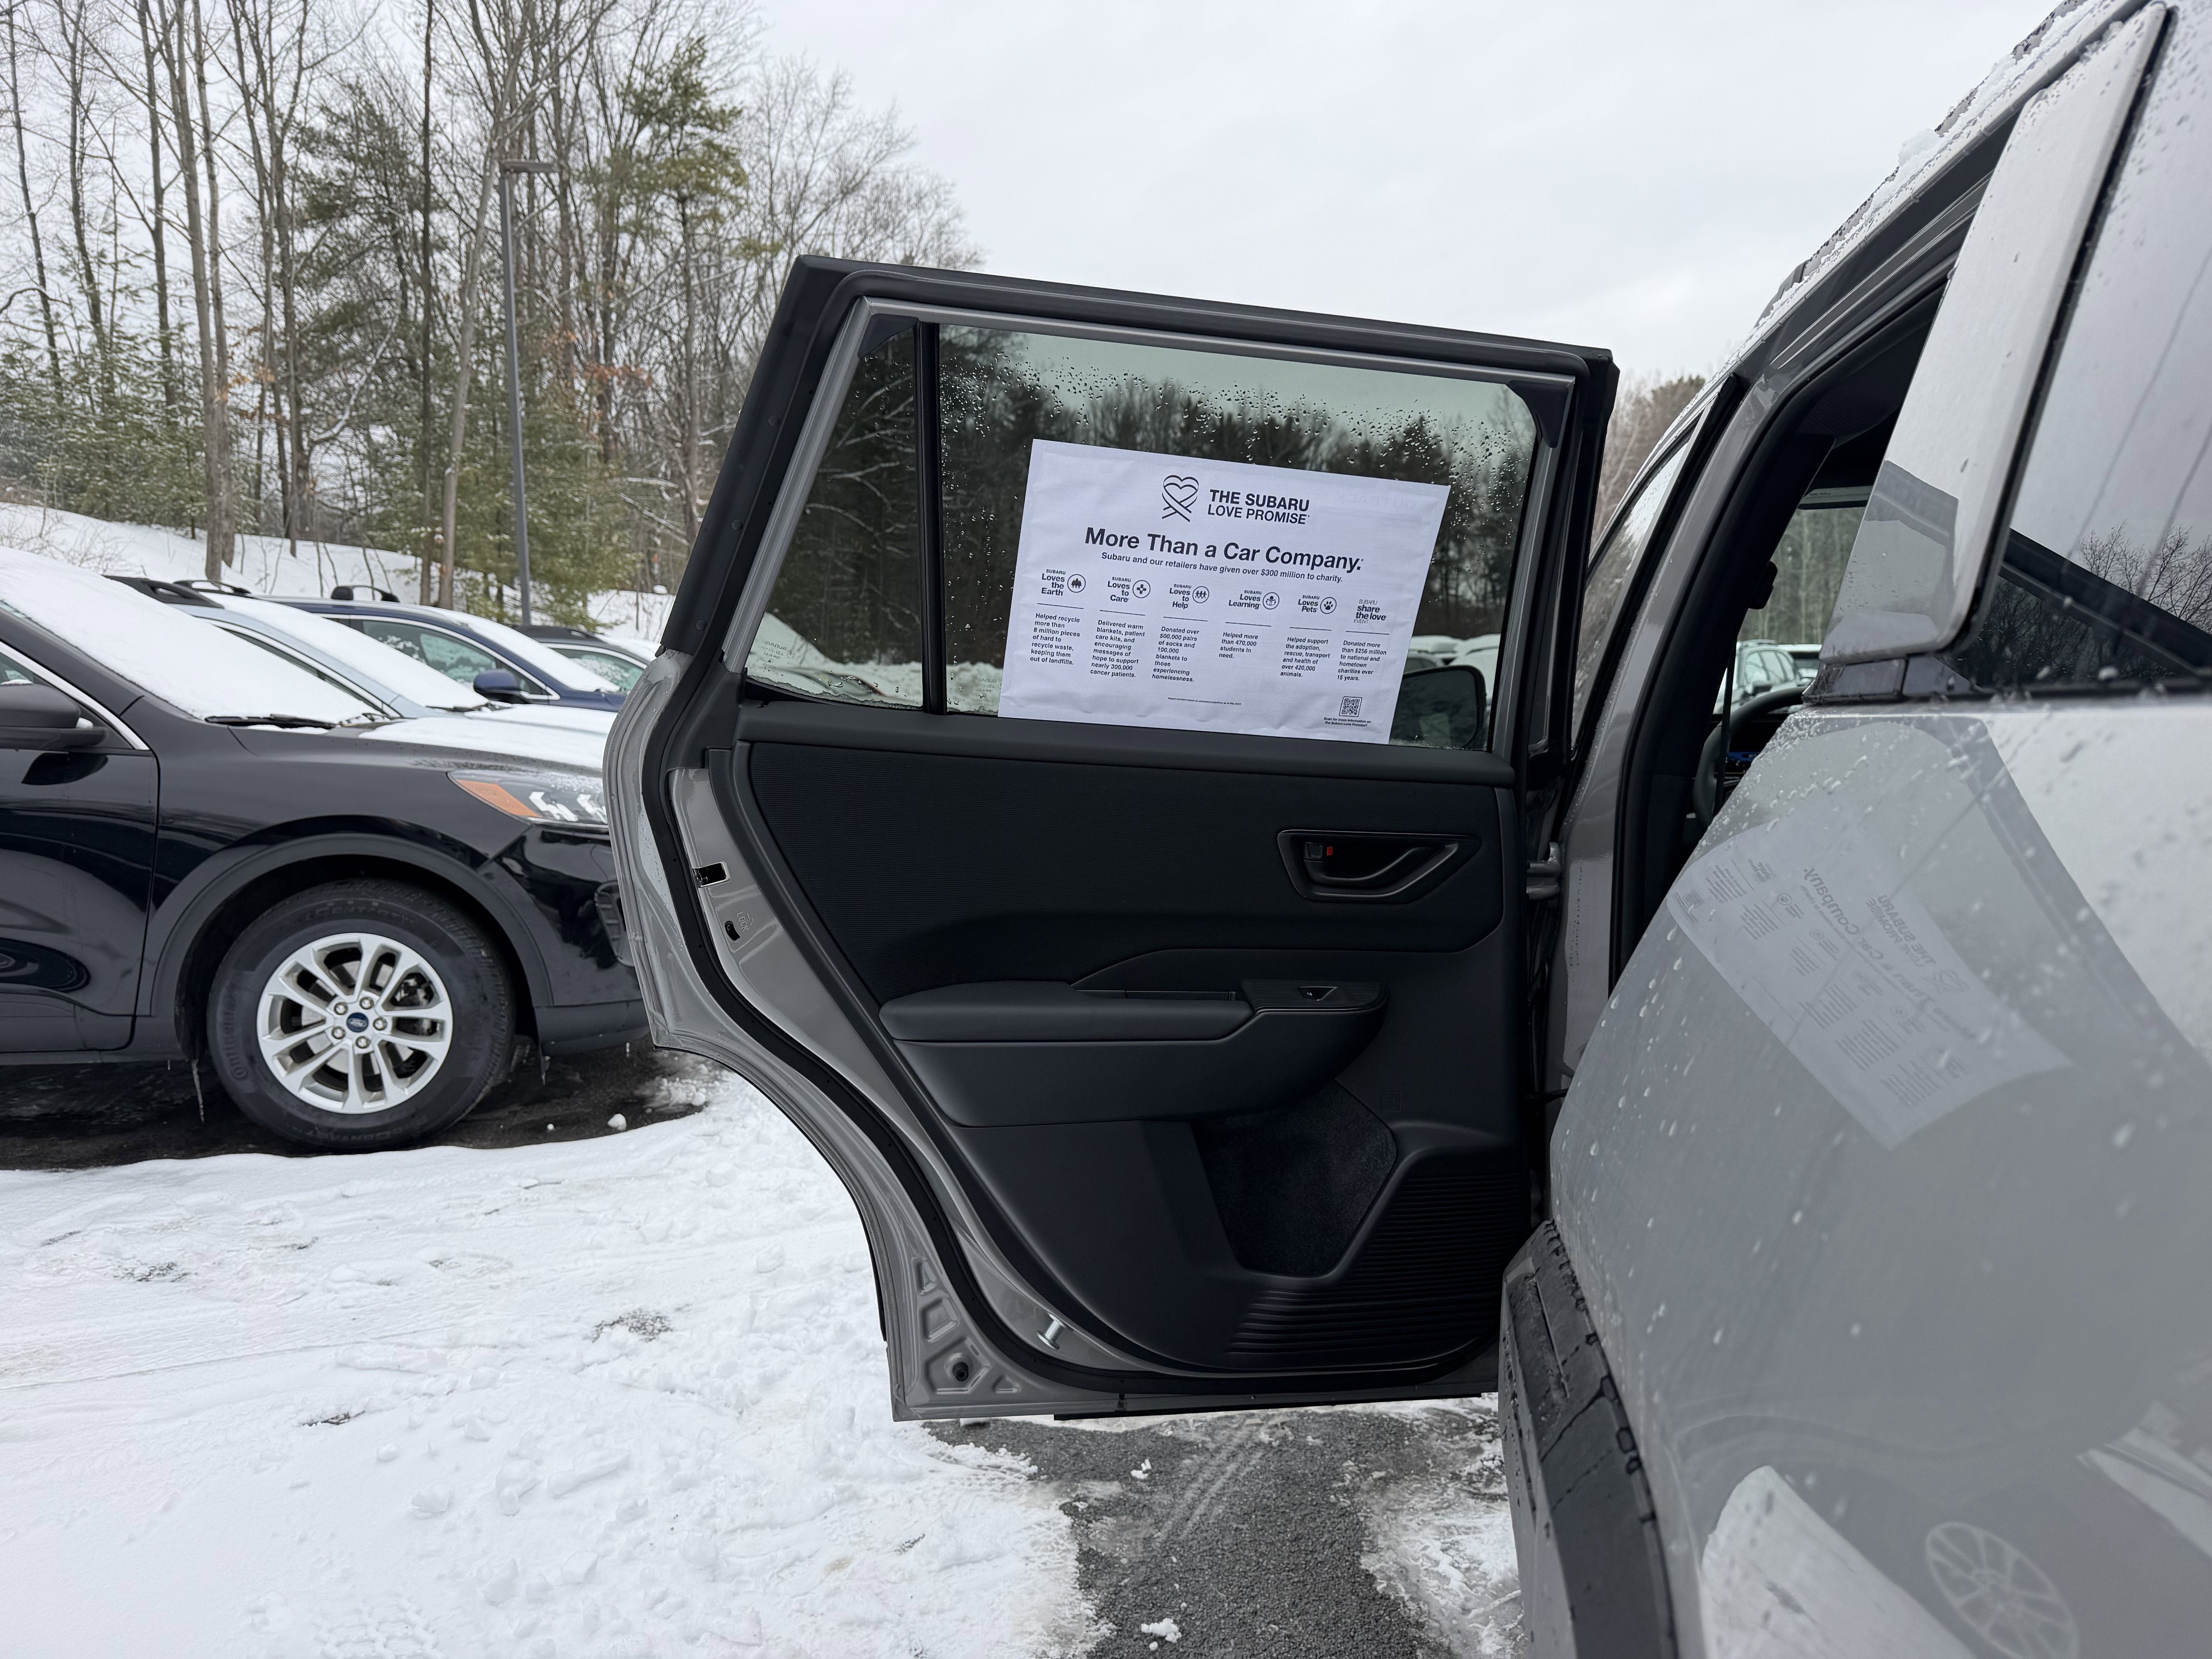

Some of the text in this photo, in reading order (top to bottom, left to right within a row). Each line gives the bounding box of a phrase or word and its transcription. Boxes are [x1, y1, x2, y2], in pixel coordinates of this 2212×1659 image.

[1210, 489, 1309, 512] THE SUBARU
[1208, 504, 1242, 518] LOVE
[1085, 527, 1139, 548] More
[1147, 534, 1198, 556] Than
[1205, 545, 1216, 558] a
[1224, 543, 1260, 561] Car
[1102, 552, 1130, 562] Subaru
[1166, 561, 1197, 569] retailers
[1317, 574, 1342, 583] charity.
[1042, 573, 1065, 582] Loves
[1108, 581, 1130, 589] Loves
[1097, 627, 1123, 635] blankets,
[1031, 649, 1054, 657] keeping
[737, 912, 749, 932] LOCK
